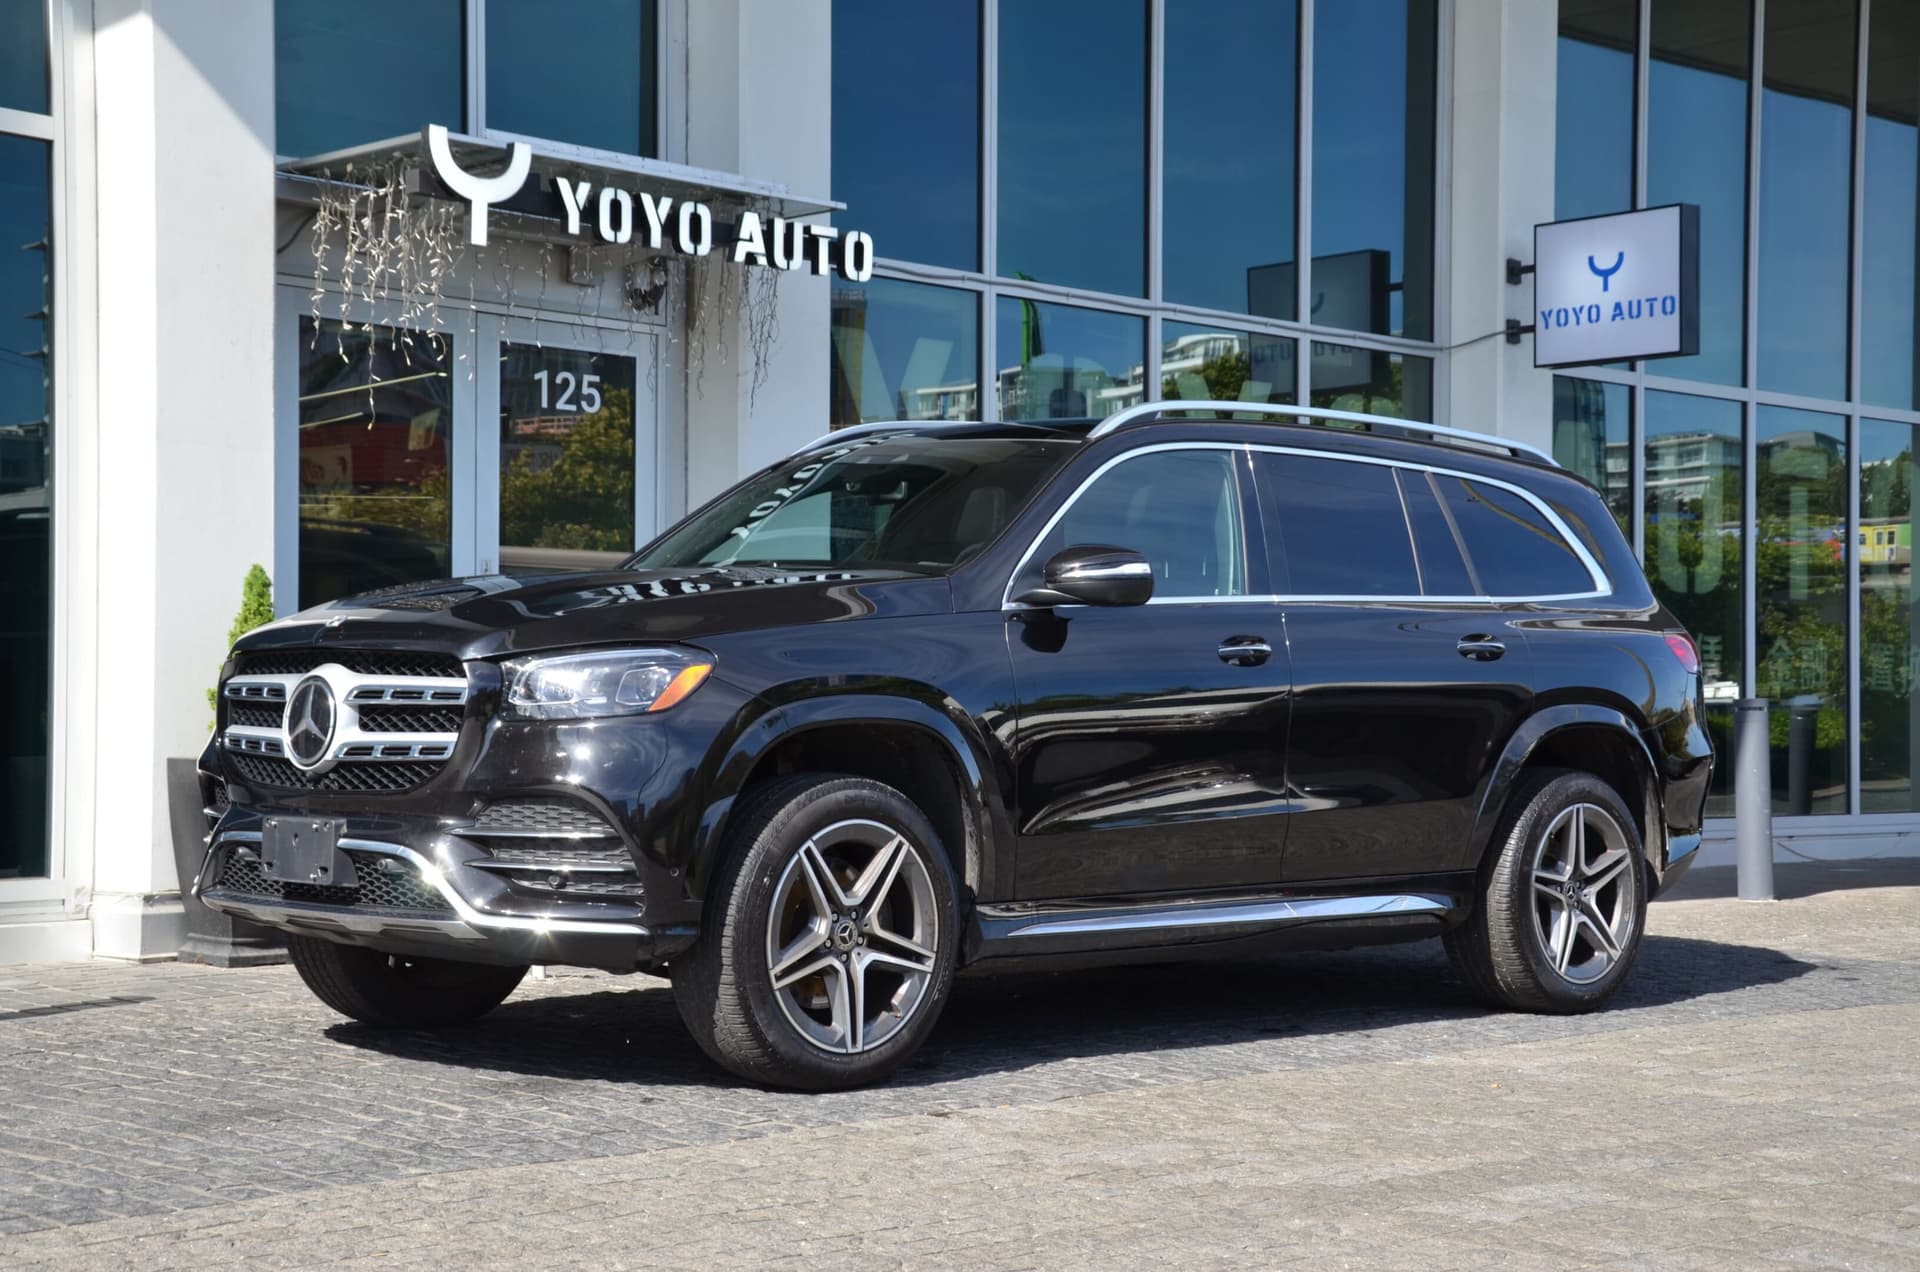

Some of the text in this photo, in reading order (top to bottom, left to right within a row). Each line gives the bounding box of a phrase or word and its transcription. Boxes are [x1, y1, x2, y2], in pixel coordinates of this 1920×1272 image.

[553, 177, 874, 283] YOYO AUTO
[1541, 295, 1676, 330] YOYO AUTO
[533, 369, 602, 414] 125
